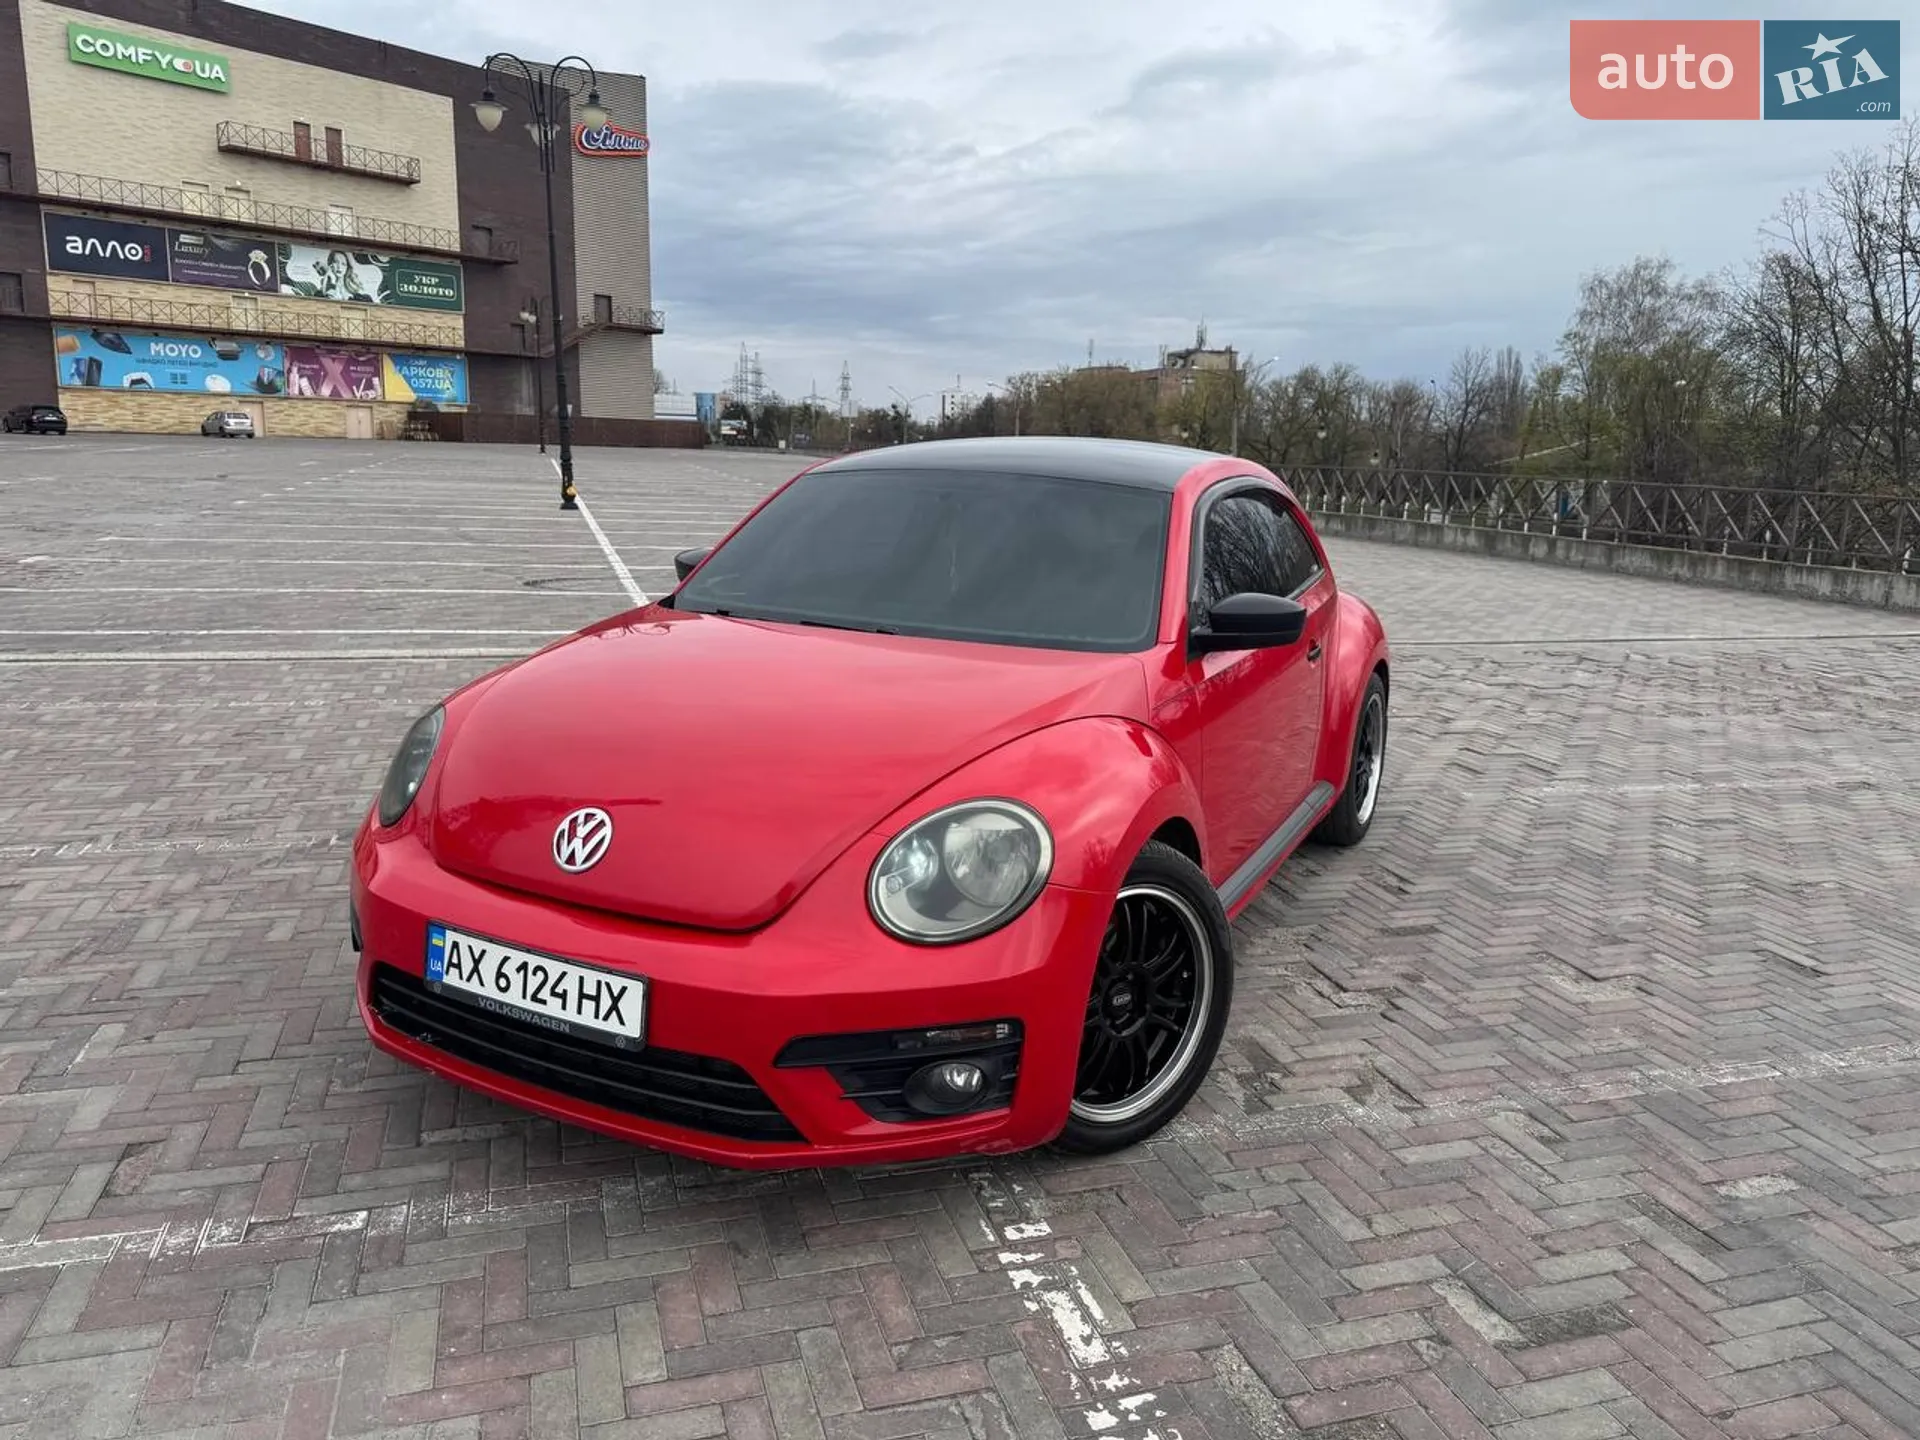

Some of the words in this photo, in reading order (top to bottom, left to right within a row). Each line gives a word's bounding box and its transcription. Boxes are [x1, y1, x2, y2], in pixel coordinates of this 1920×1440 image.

[75, 33, 172, 70] COMFY
[175, 242, 211, 260] Luxury
[413, 274, 440, 285] УКР
[399, 283, 454, 296] ЗОЛОТО
[150, 342, 202, 358] MOYO
[430, 957, 443, 973] UA
[445, 941, 486, 987] AX
[495, 956, 568, 1010] 6124
[576, 975, 628, 1026] HX
[478, 997, 571, 1033] VOLKSWAGEN
